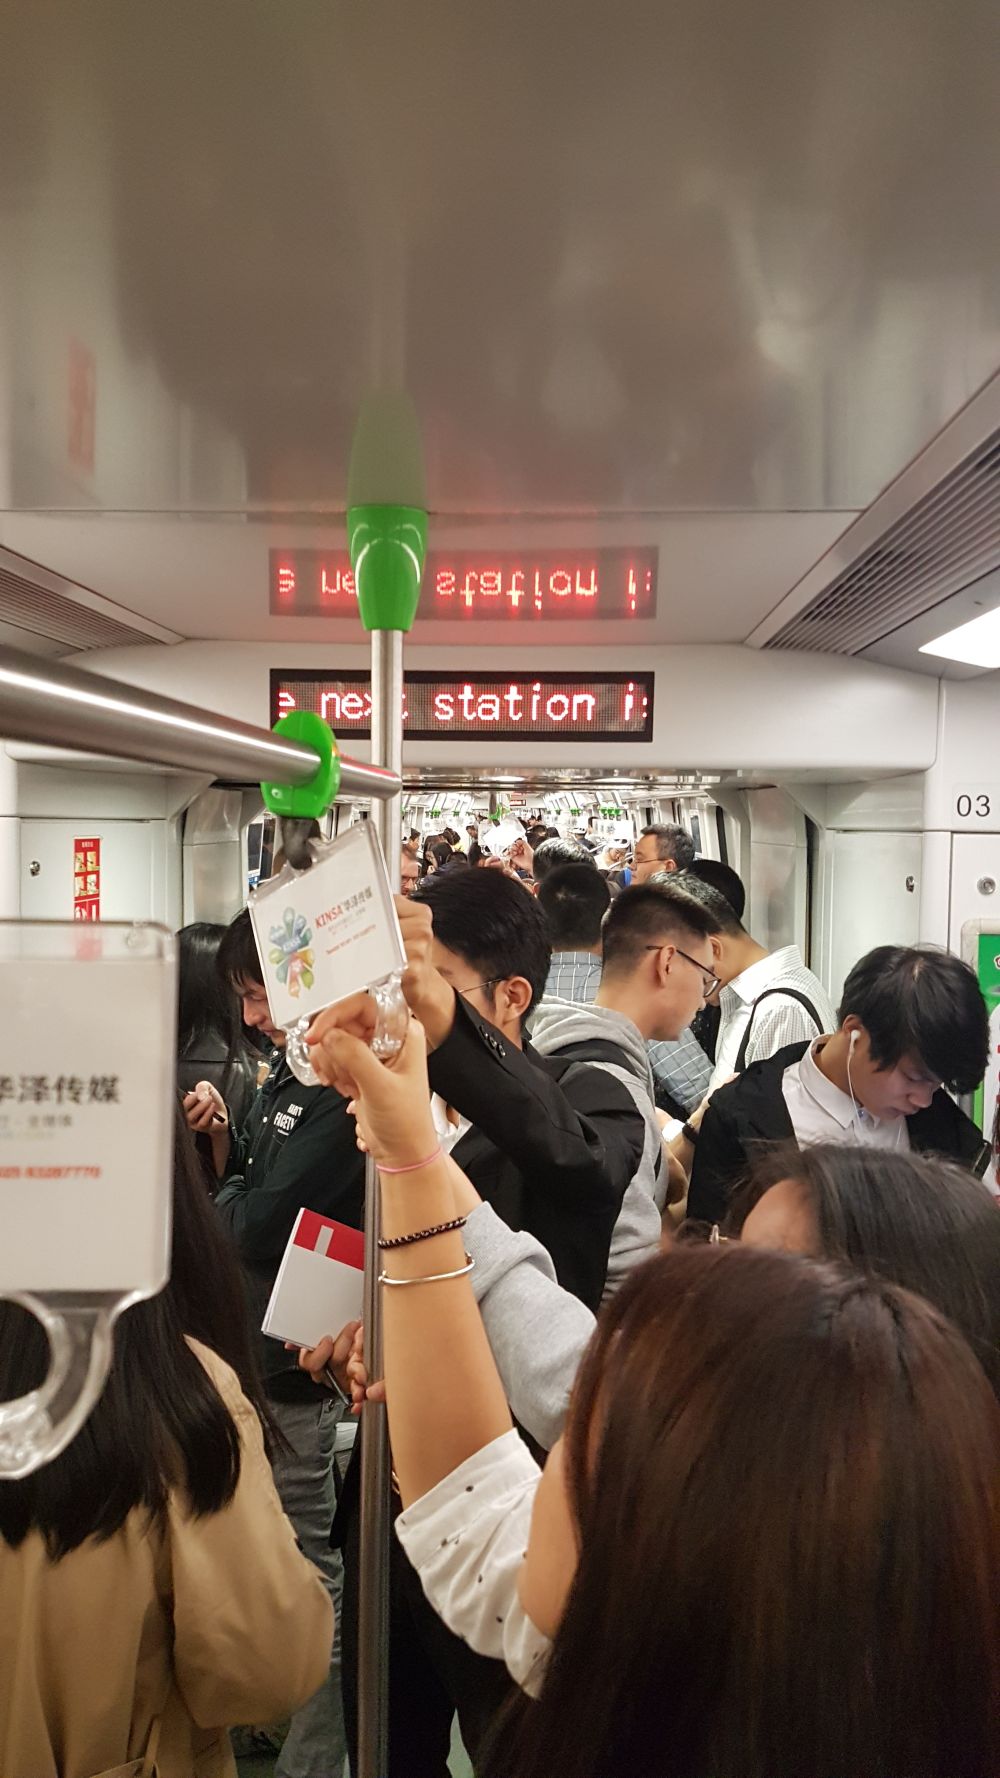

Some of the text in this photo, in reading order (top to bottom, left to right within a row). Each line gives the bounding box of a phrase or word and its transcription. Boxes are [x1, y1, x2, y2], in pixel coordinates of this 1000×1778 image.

[321, 691, 408, 719] ne
[434, 682, 596, 721] station
[957, 794, 990, 817] 03
